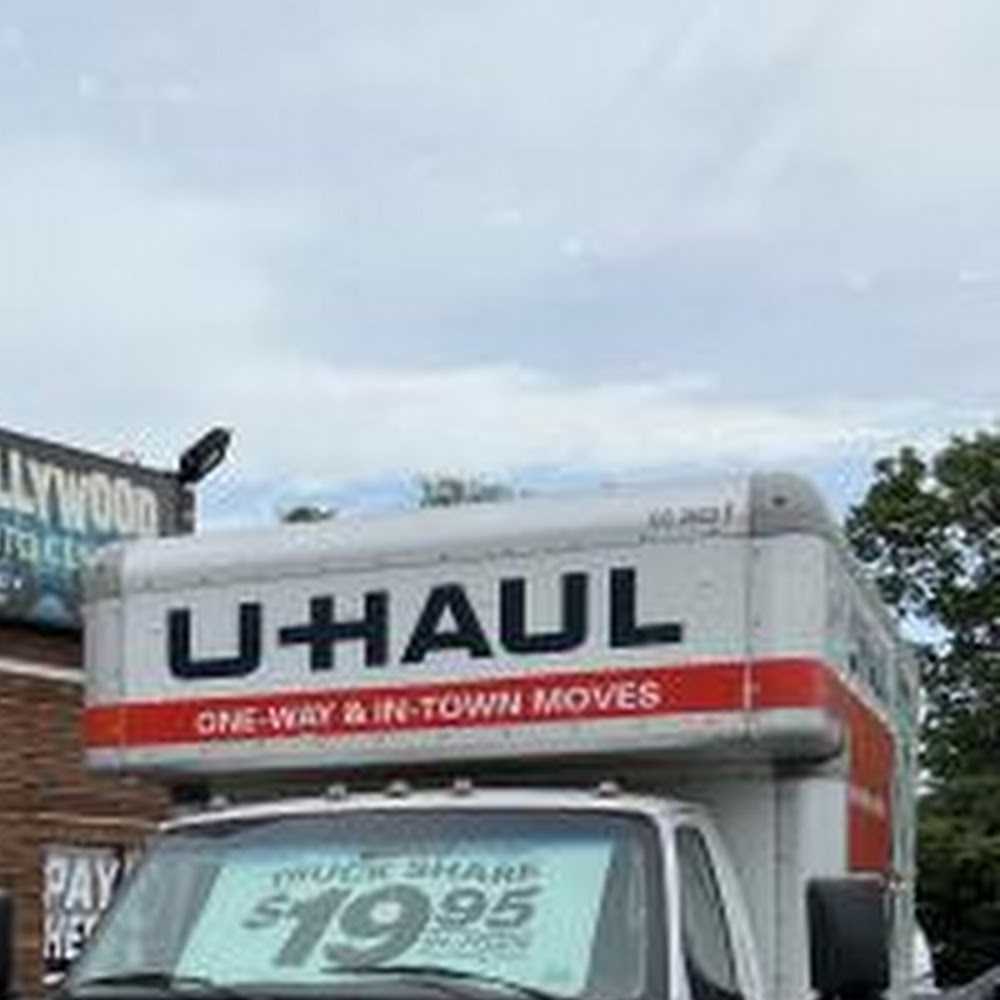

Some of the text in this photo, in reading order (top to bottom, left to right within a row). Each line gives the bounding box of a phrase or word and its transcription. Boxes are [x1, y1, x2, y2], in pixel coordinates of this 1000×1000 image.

[168, 565, 683, 680] U-HAUL
[196, 681, 662, 736] ONE-WAY & IN-TOWN MOVES
[43, 856, 121, 910] PAY
[43, 913, 99, 960] HE
